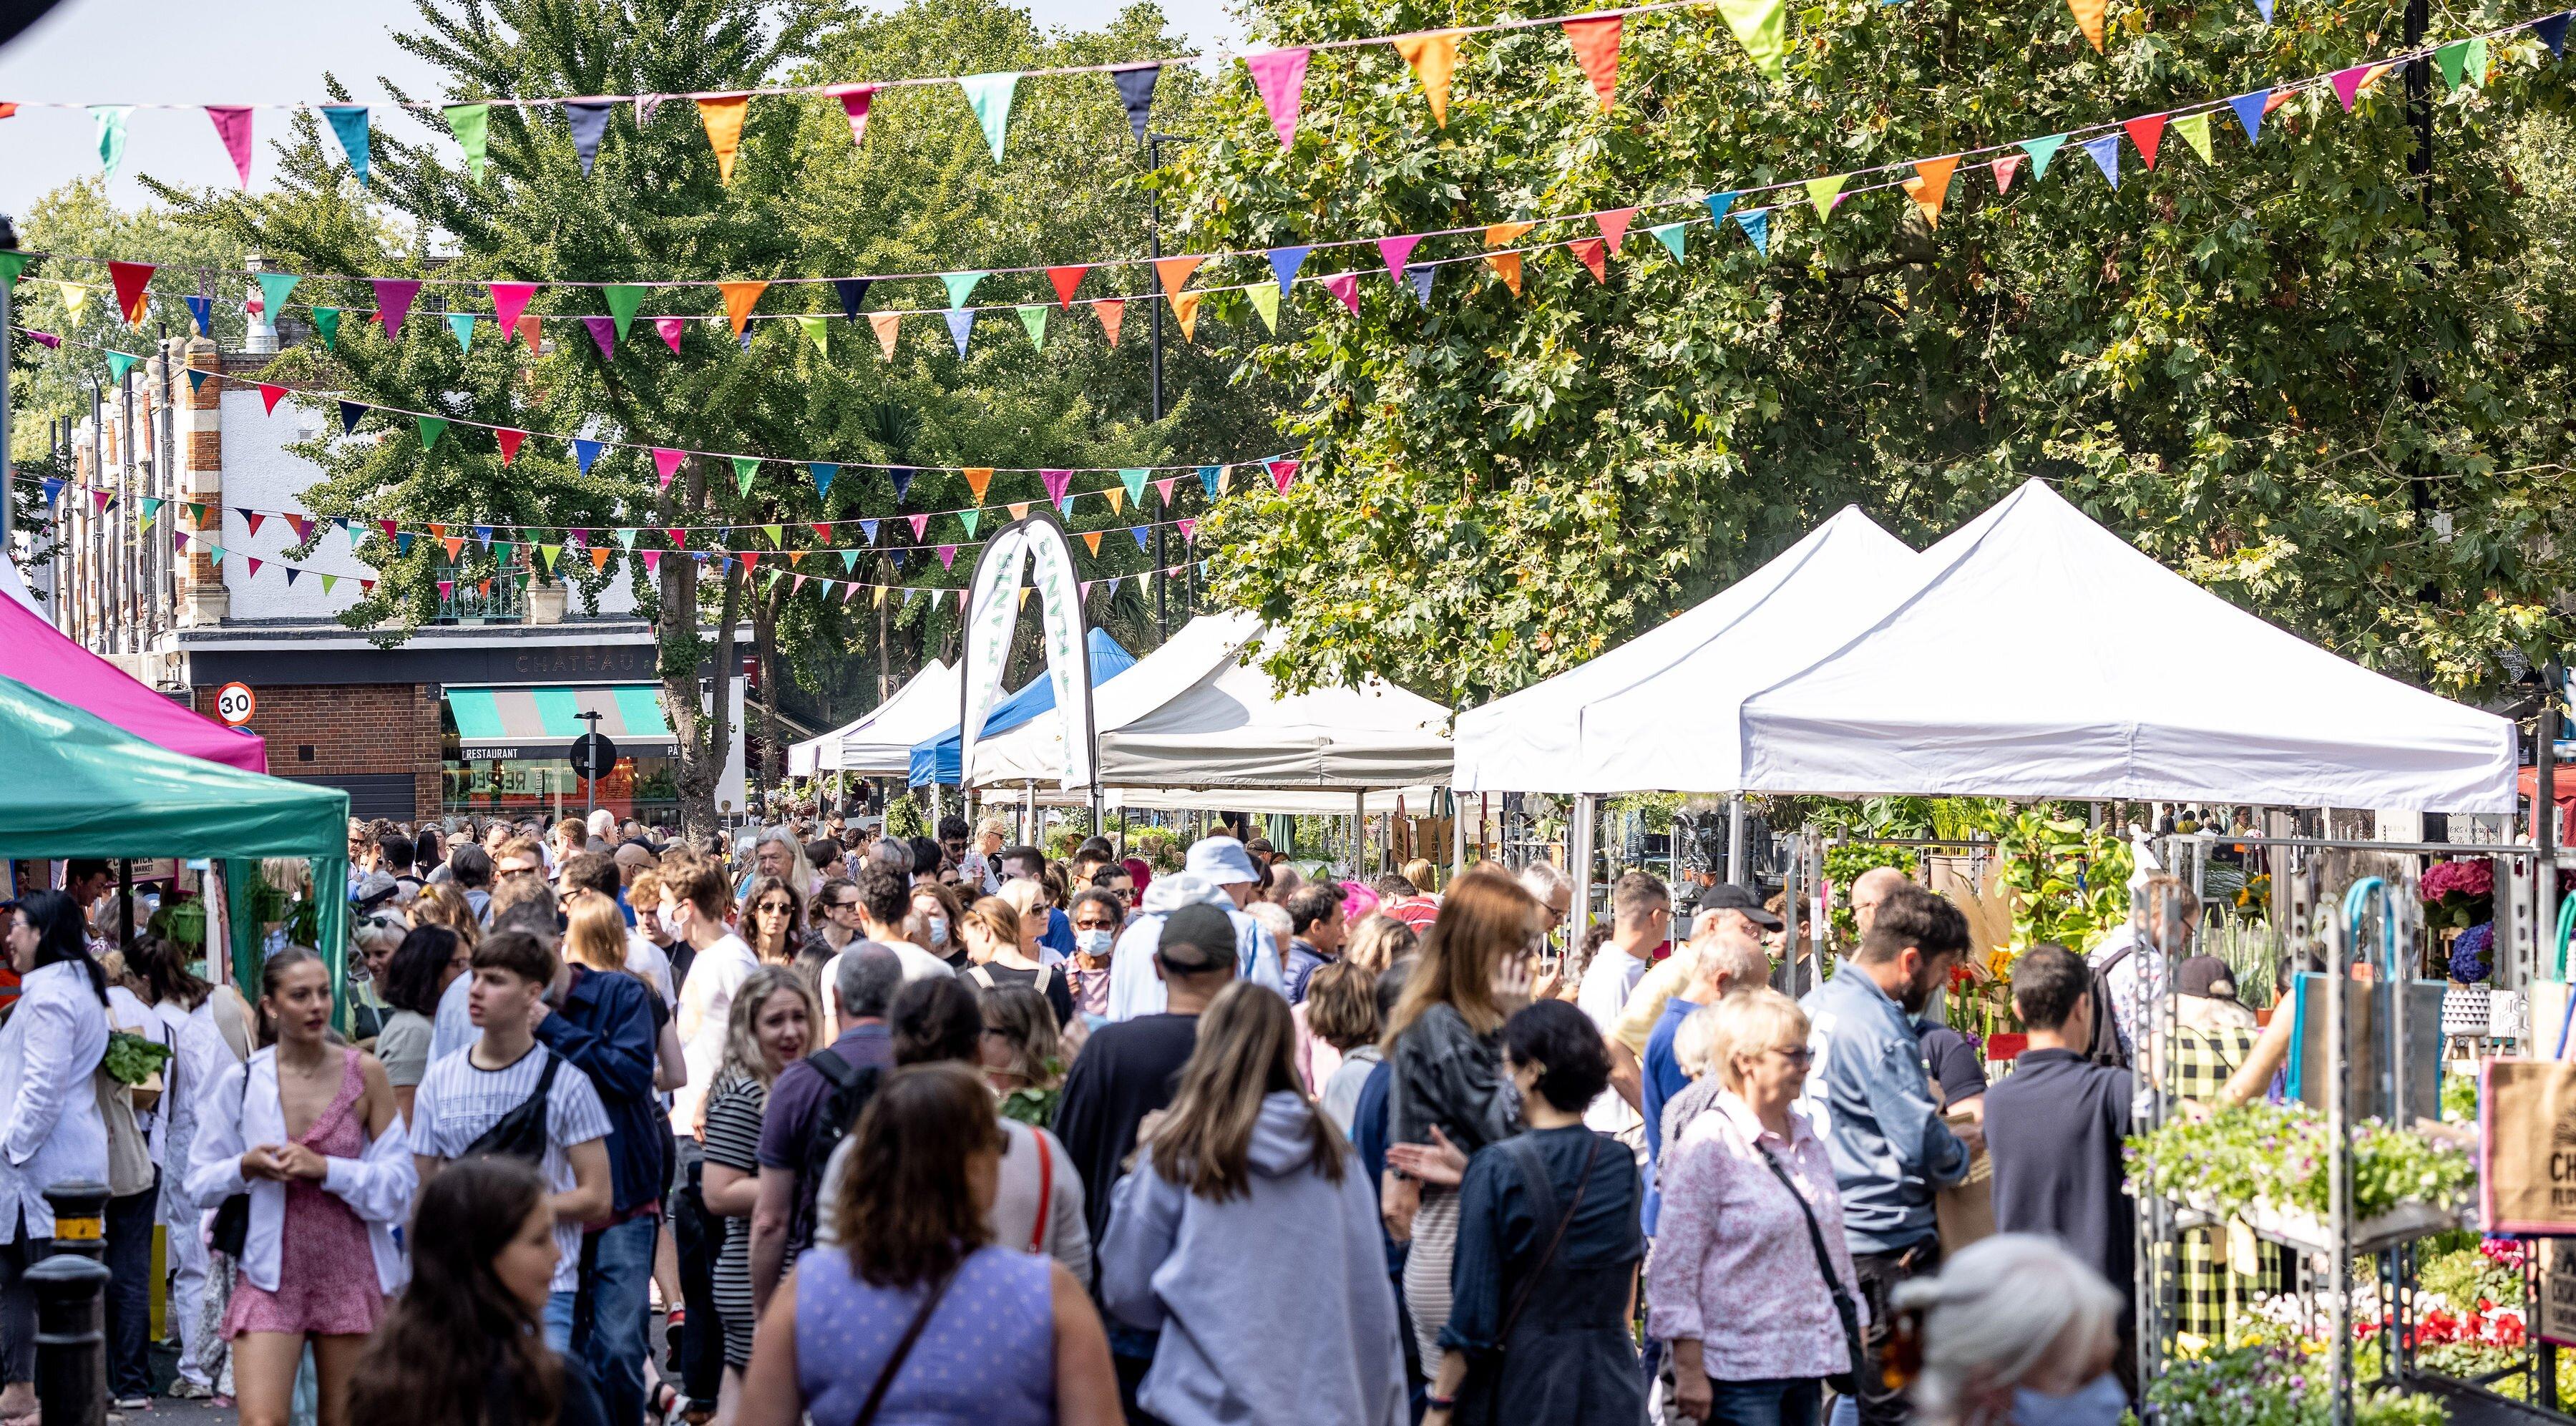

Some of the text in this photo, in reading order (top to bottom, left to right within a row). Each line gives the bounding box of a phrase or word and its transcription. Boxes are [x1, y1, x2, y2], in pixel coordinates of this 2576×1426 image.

[515, 654, 635, 673] CHATEAU
[220, 694, 249, 714] 30
[466, 748, 518, 758] RESTAURANT
[134, 864, 153, 873] MARKET
